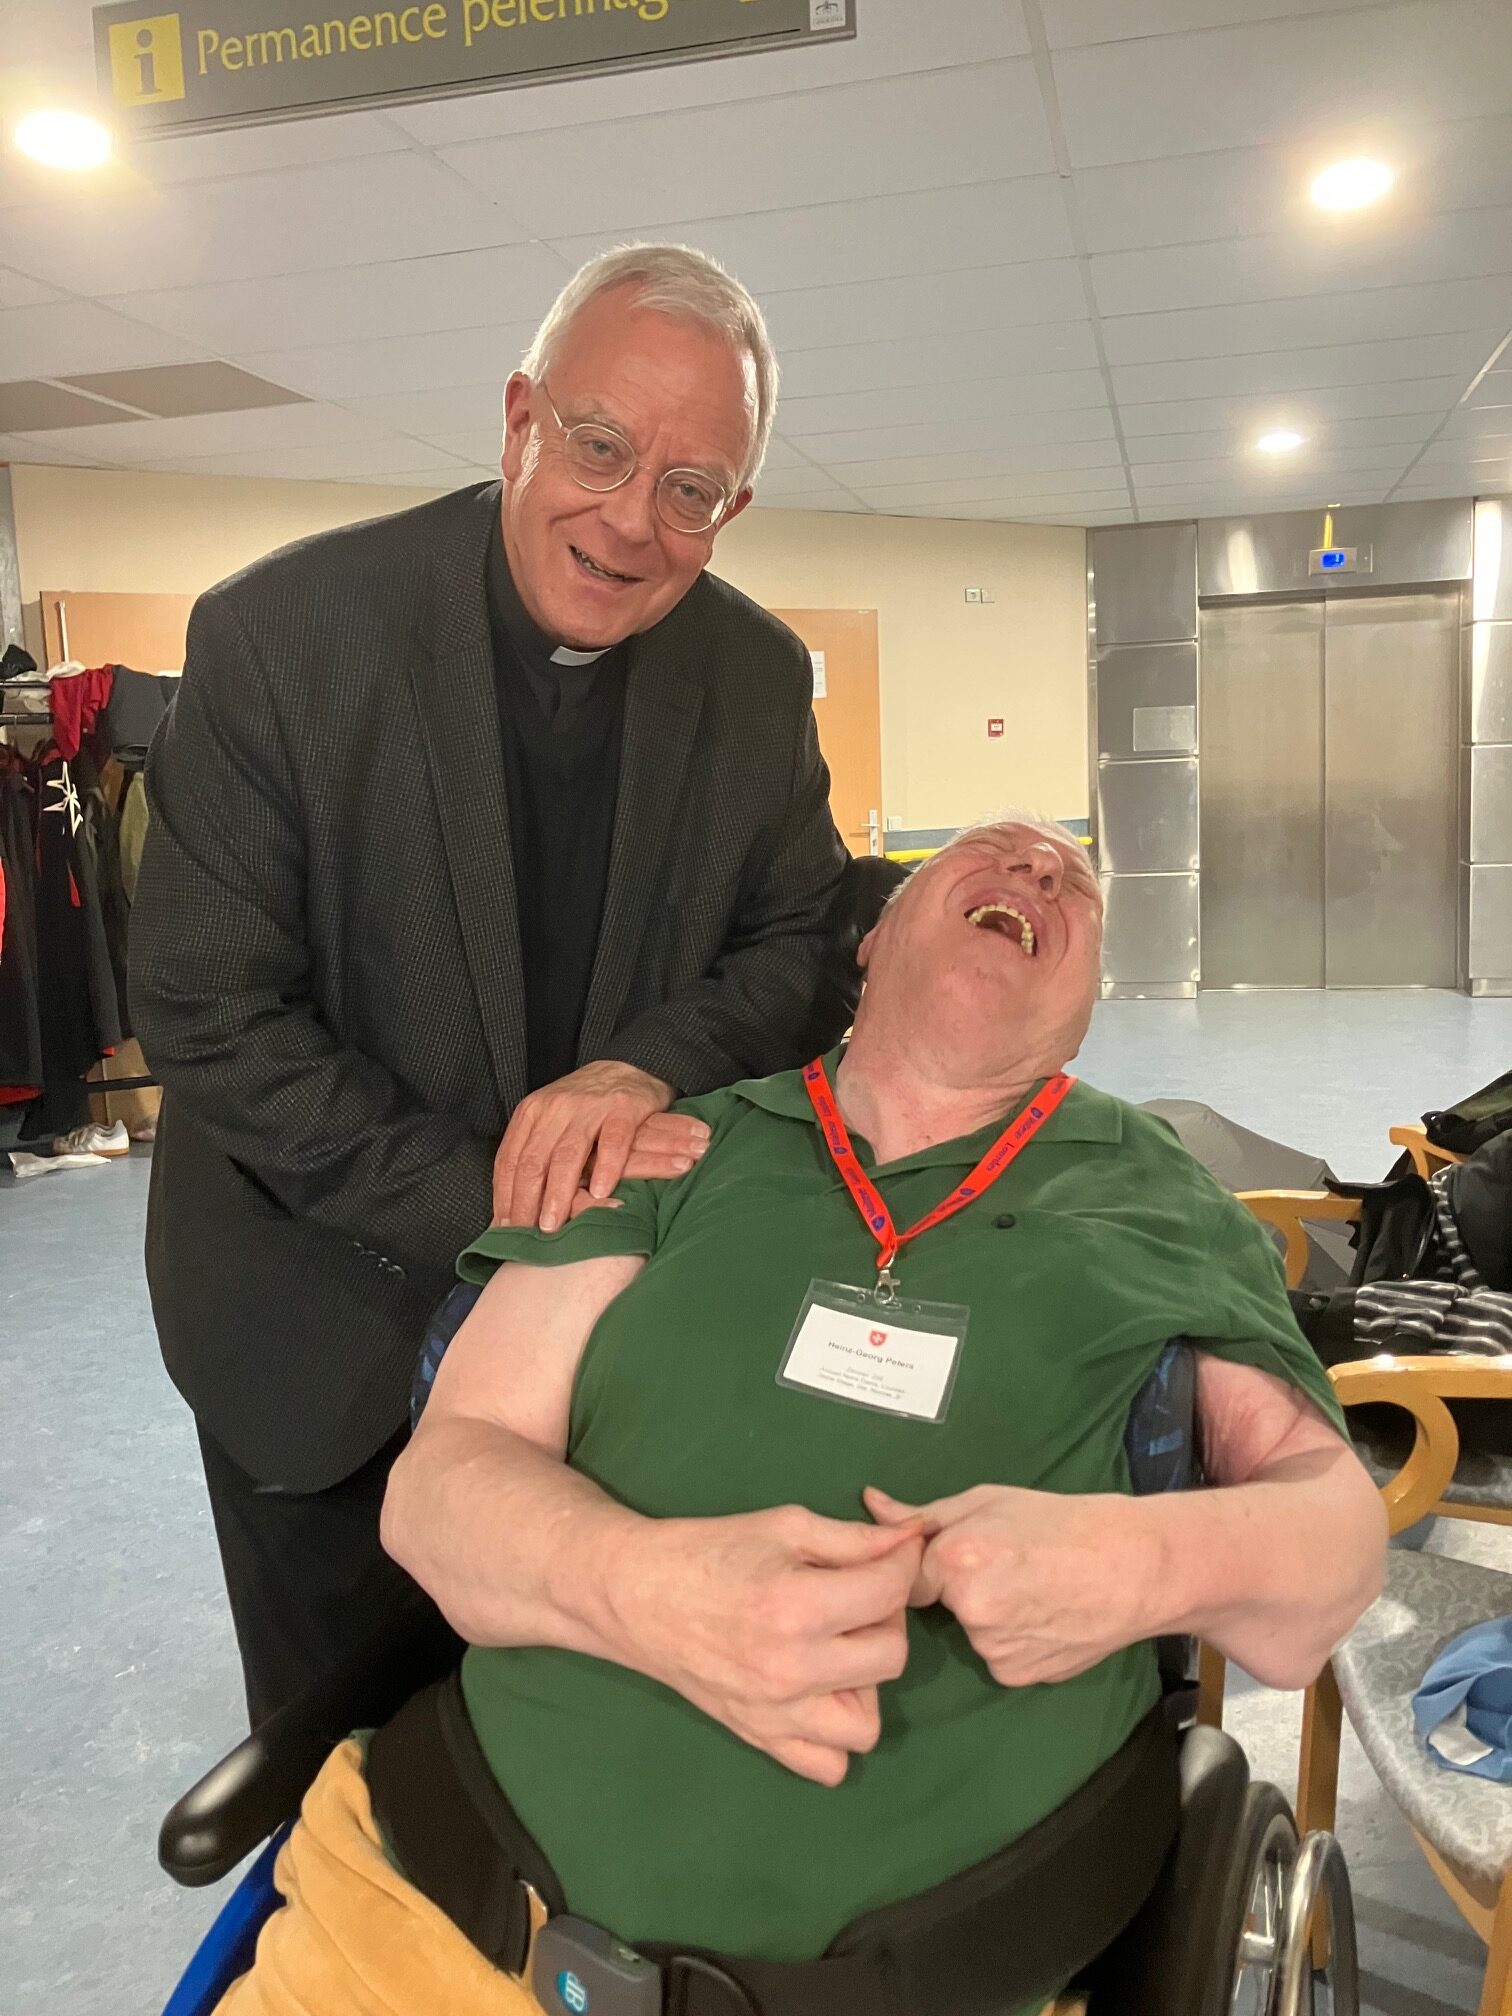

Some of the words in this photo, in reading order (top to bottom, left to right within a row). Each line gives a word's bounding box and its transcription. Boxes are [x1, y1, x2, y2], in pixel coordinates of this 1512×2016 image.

[196, 3, 447, 75] Permanence
[828, 1341, 883, 1363] Heinz-Georg
[885, 1357, 914, 1369] Peters
